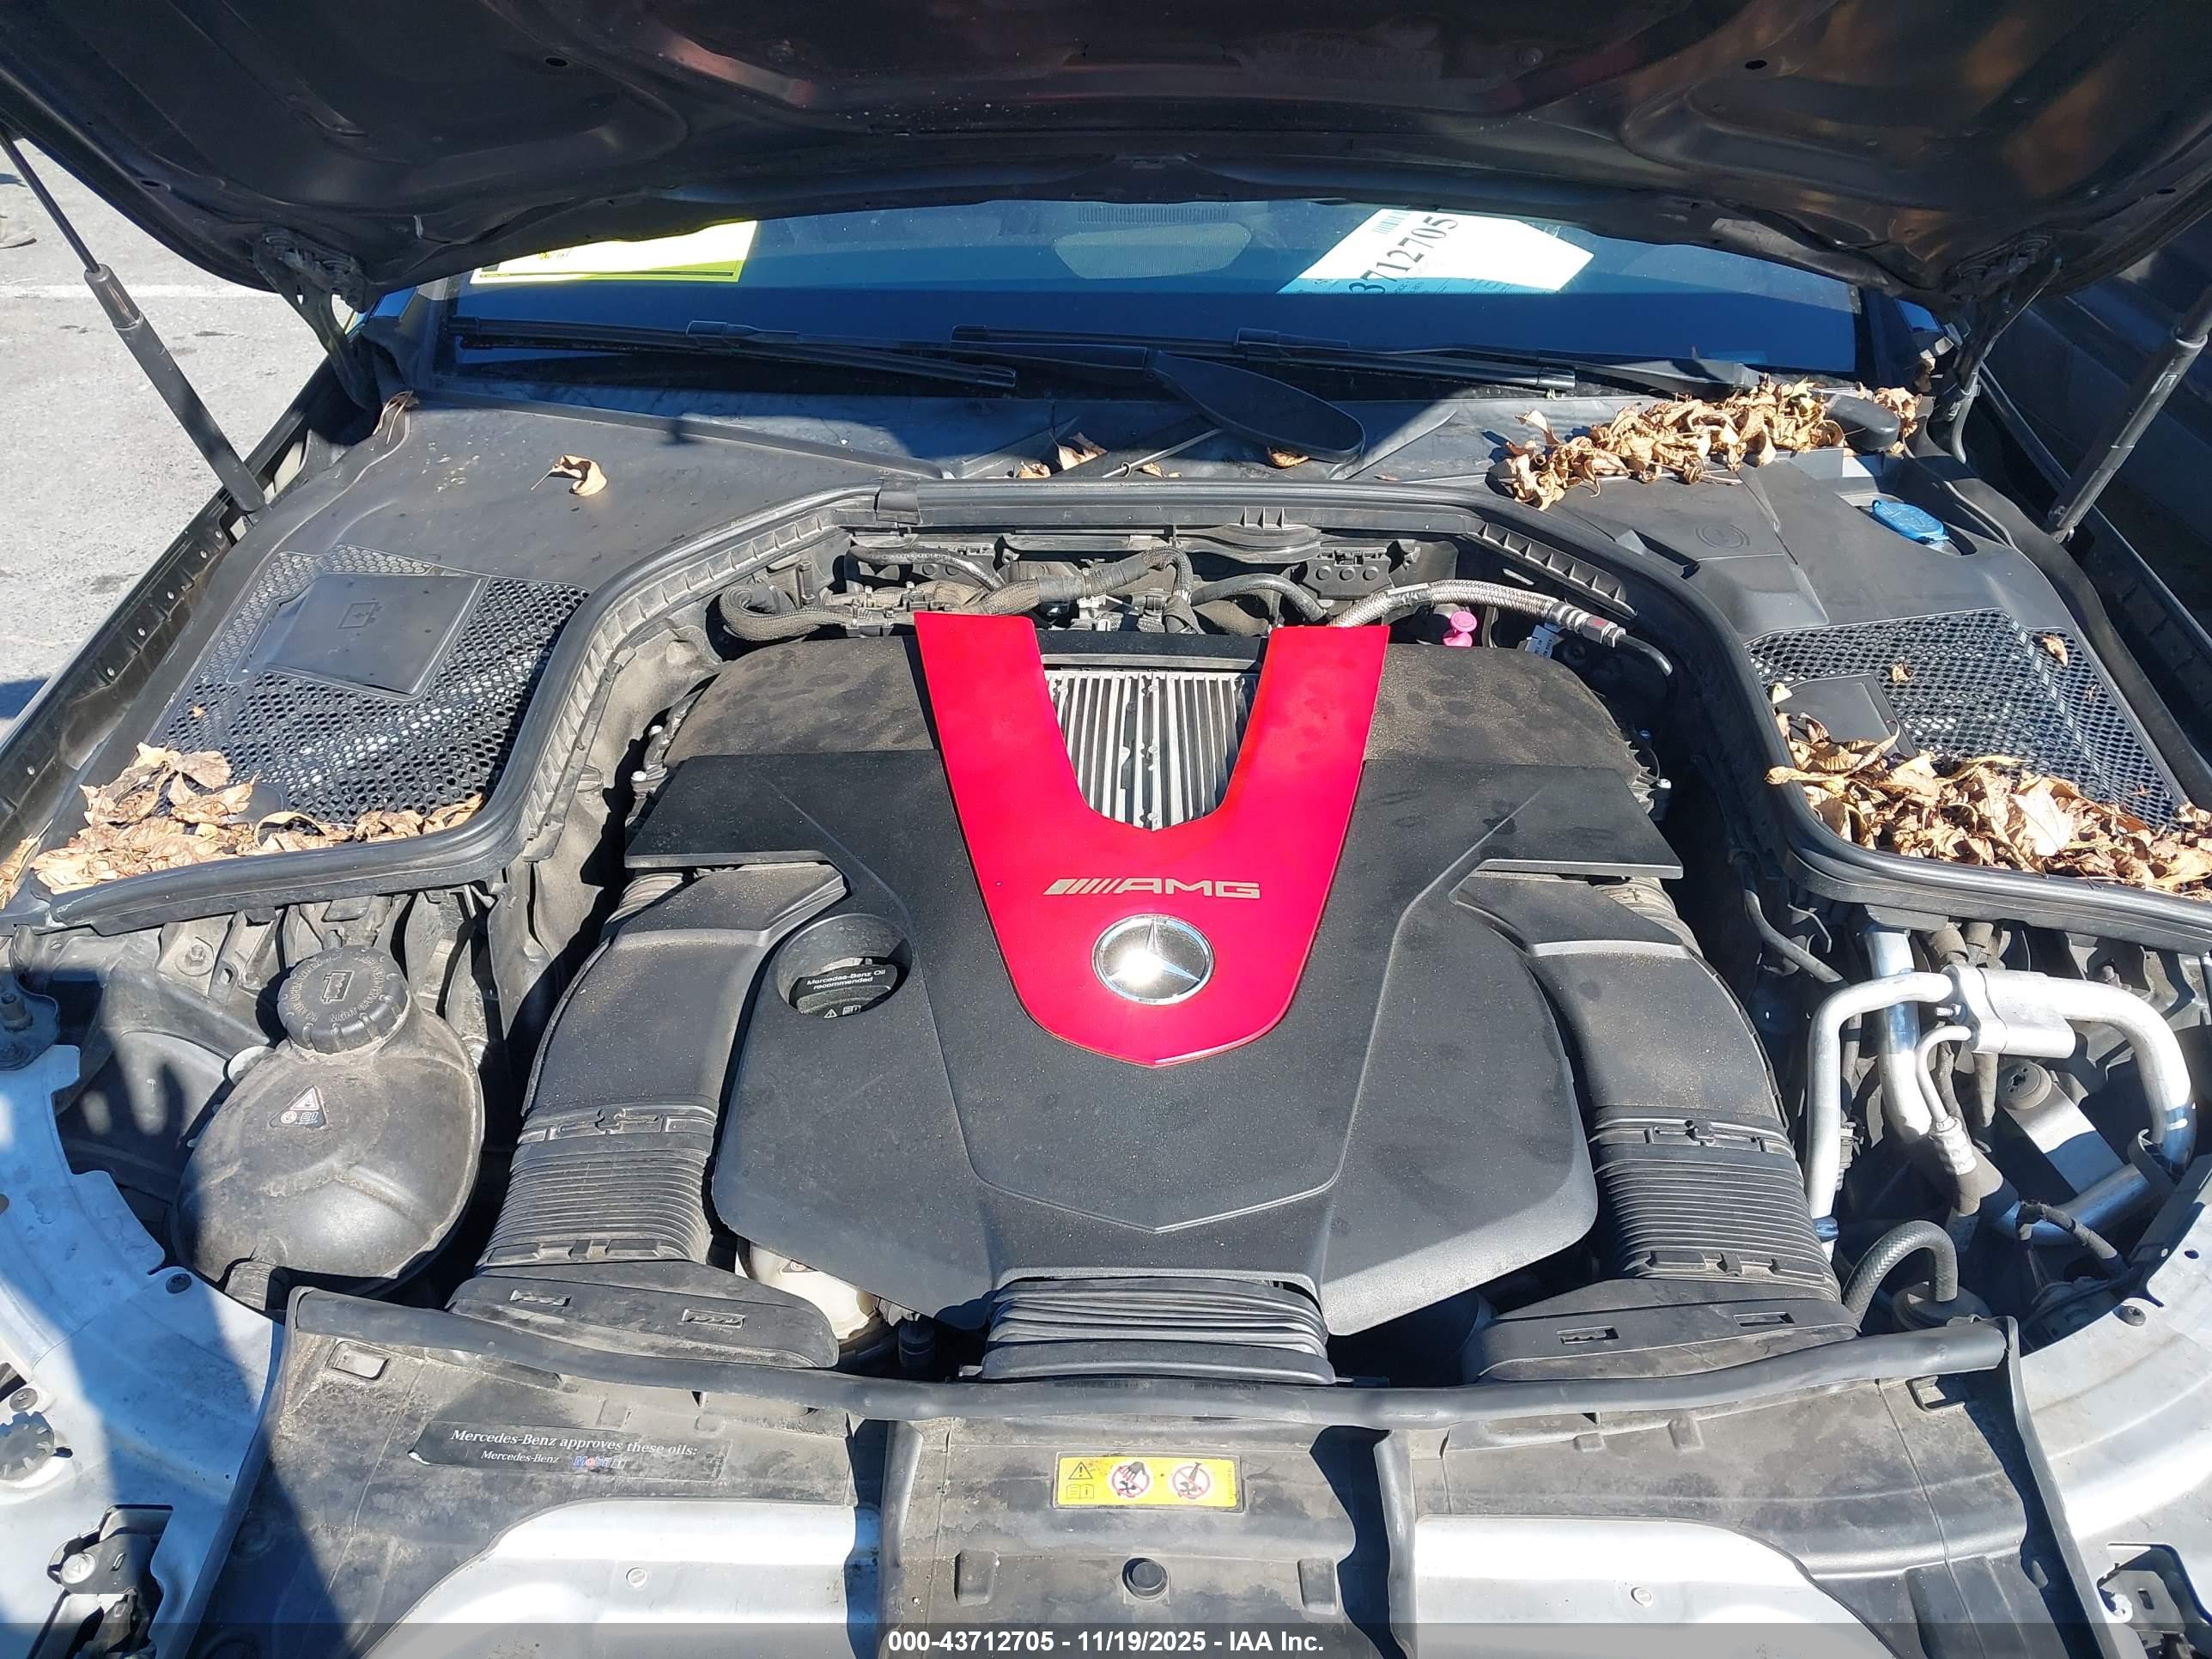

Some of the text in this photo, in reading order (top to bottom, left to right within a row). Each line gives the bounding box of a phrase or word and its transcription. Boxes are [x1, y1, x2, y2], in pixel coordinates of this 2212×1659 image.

[806, 971, 872, 986] Mercedes-Benz
[812, 976, 873, 990] recommended
[450, 1429, 698, 1455] Mercedes-Benz approves these oils:
[481, 1450, 560, 1464] Mercedes-Benz
